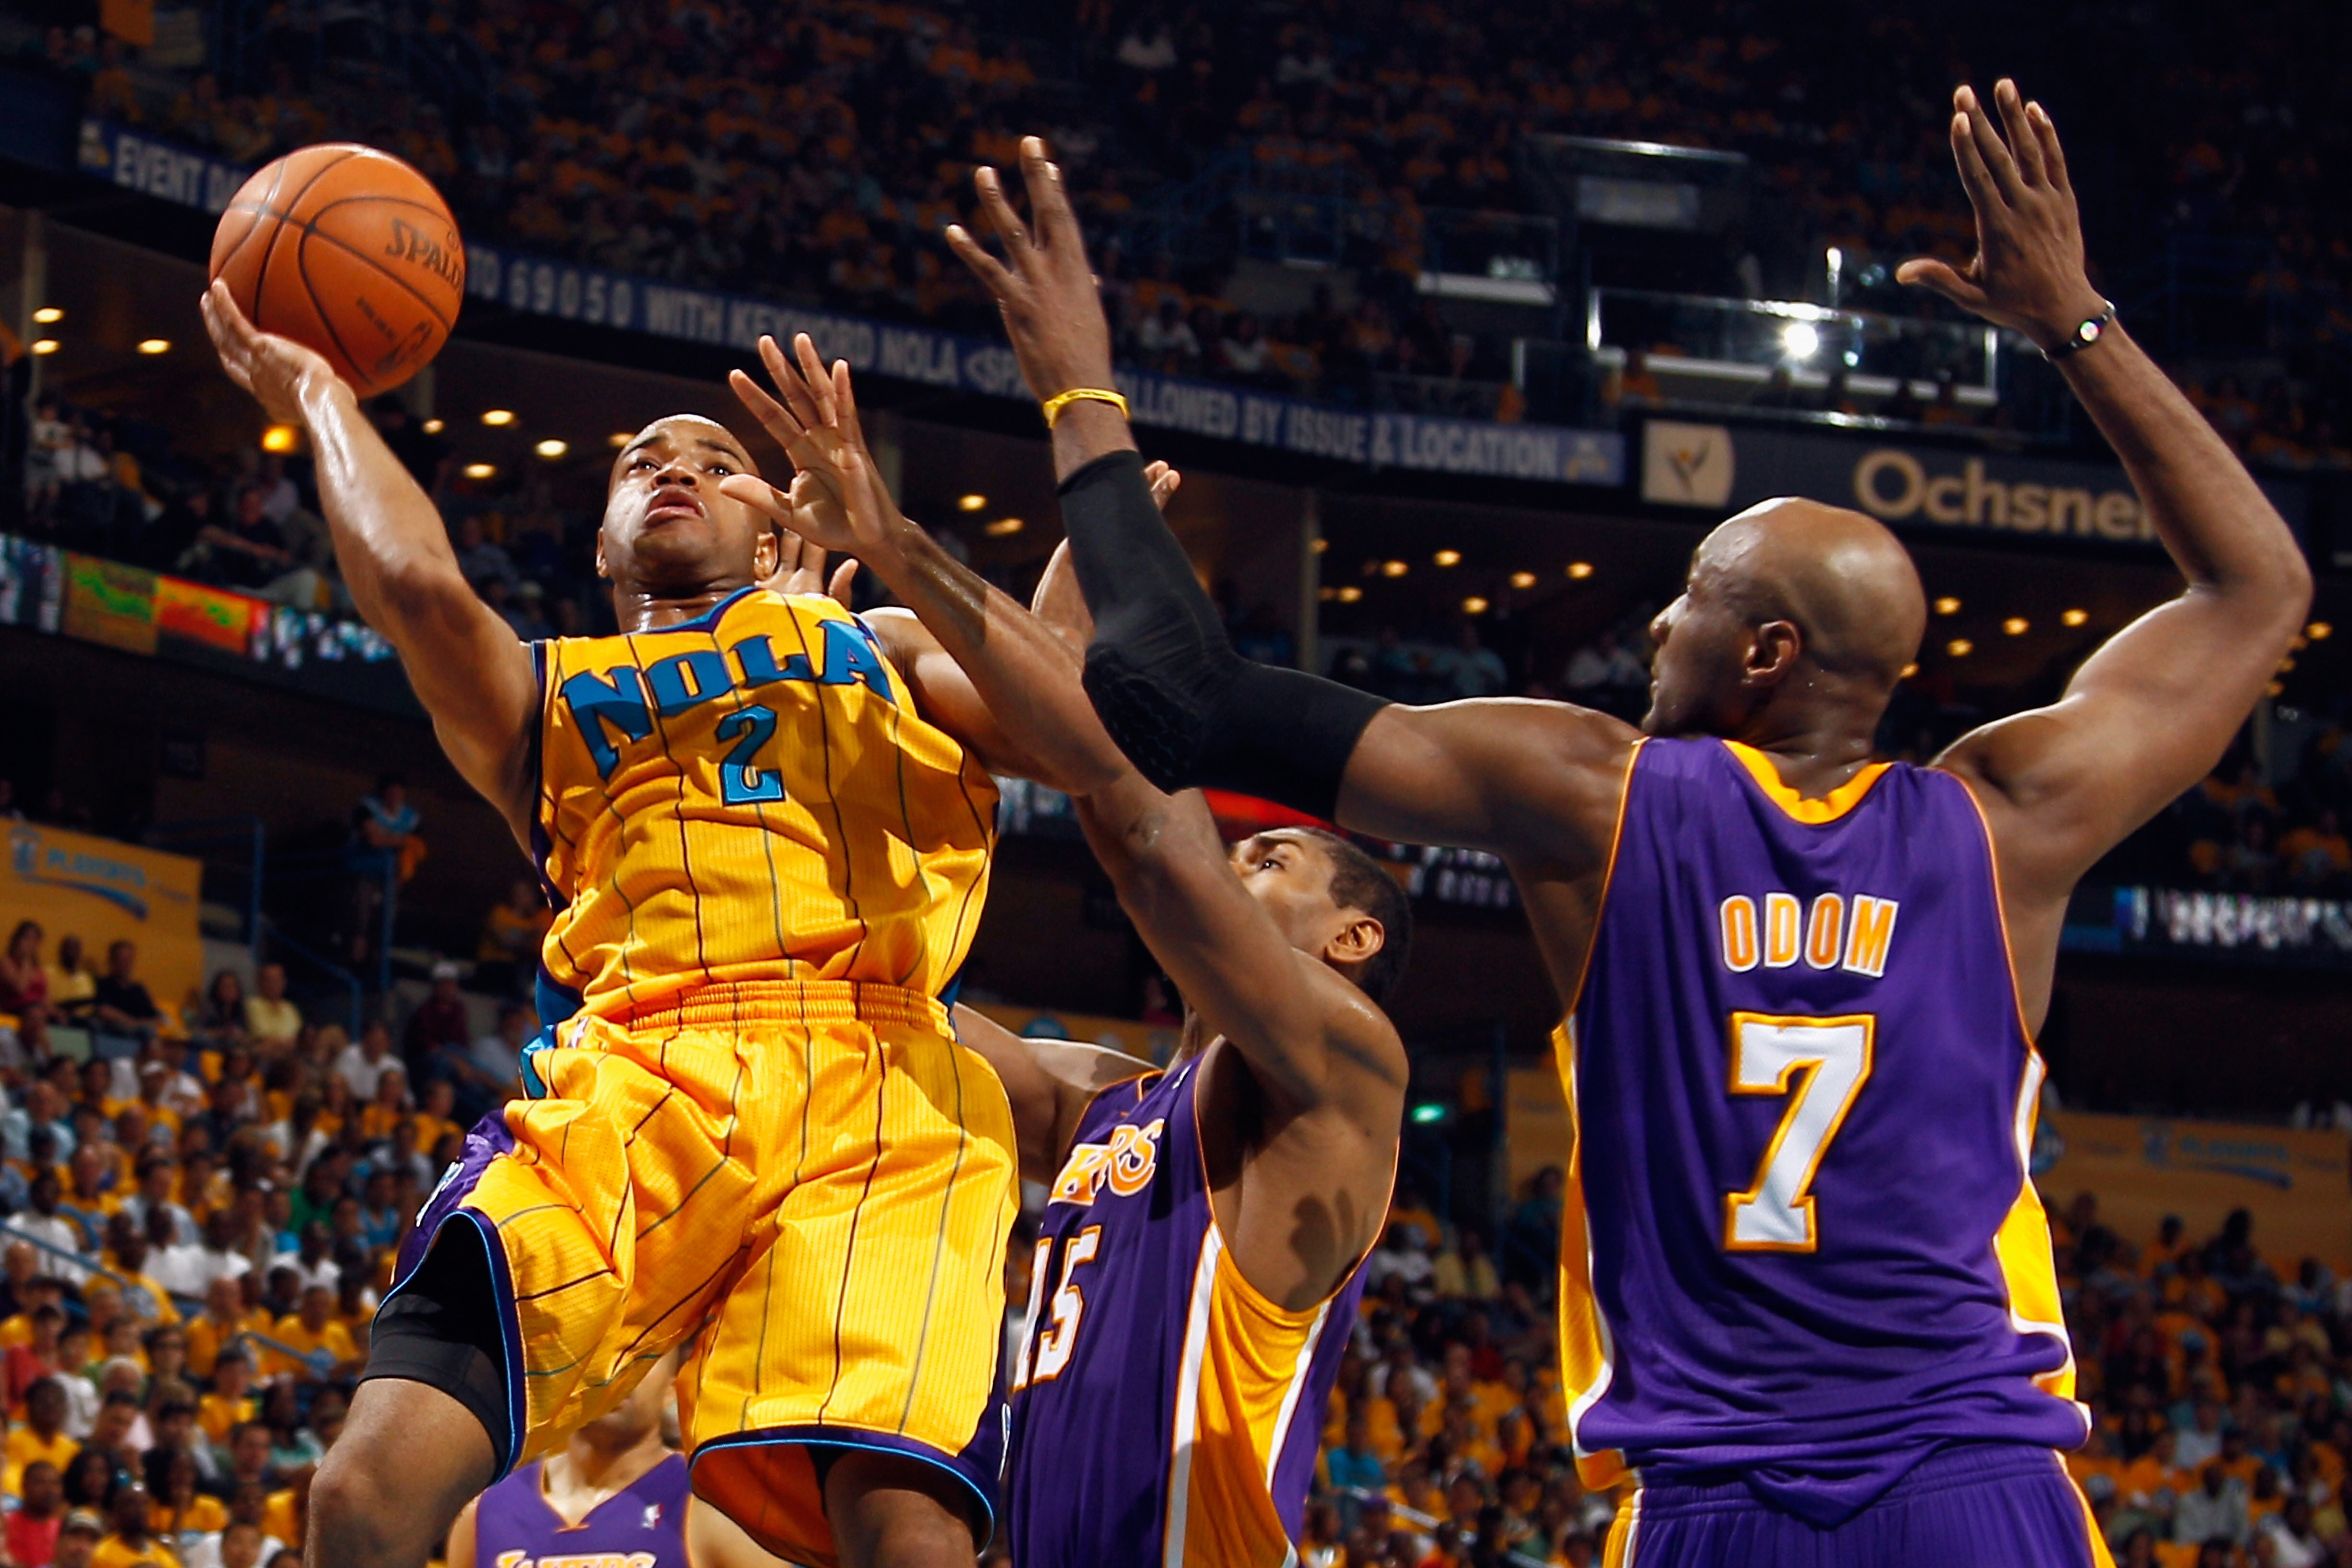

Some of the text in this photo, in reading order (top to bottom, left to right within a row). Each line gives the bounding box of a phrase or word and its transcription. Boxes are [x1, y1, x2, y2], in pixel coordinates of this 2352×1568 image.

[116, 133, 205, 208] EVENT
[509, 258, 632, 329] 69050
[646, 286, 724, 345] WITH
[729, 299, 875, 370] KEYWORD
[878, 325, 958, 386] NOLA
[1243, 394, 1282, 448] BY
[1287, 404, 1368, 462] ISSUE
[1395, 417, 1559, 479] LOCATION
[559, 619, 897, 784] NOLA
[714, 704, 786, 807] 2
[1720, 892, 1899, 978] ODOM
[1724, 1011, 1877, 1253] 7
[1013, 1224, 1102, 1392] 15
